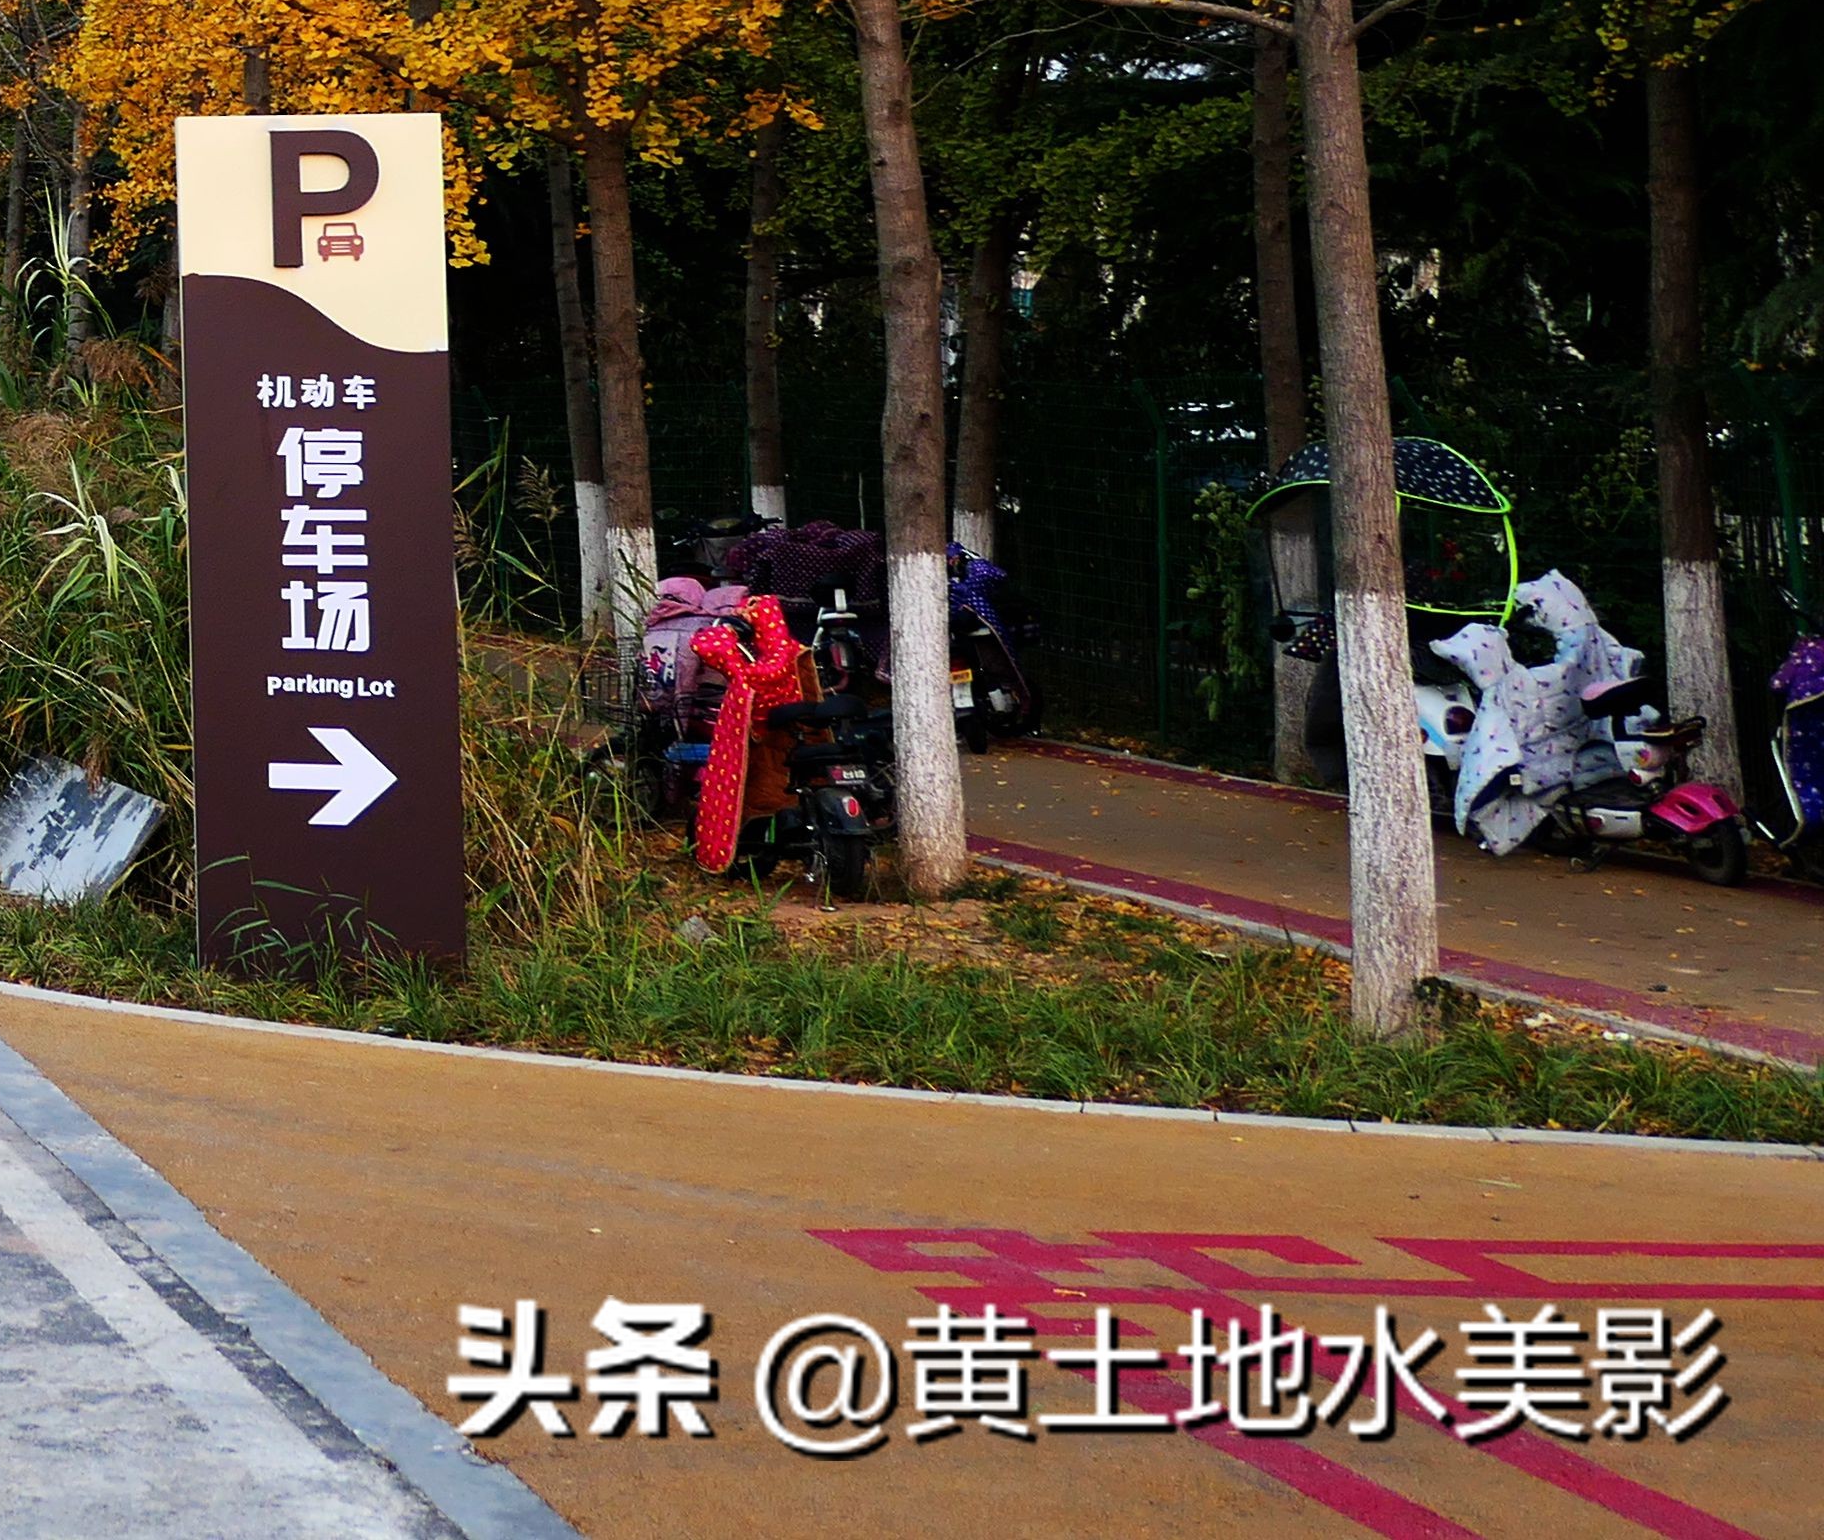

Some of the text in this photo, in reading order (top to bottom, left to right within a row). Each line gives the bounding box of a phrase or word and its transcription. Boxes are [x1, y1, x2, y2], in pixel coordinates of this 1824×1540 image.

[269, 130, 379, 267] P
[257, 373, 377, 410] 机动车
[276, 426, 371, 652] 停车场
[357, 676, 396, 698] Lot
